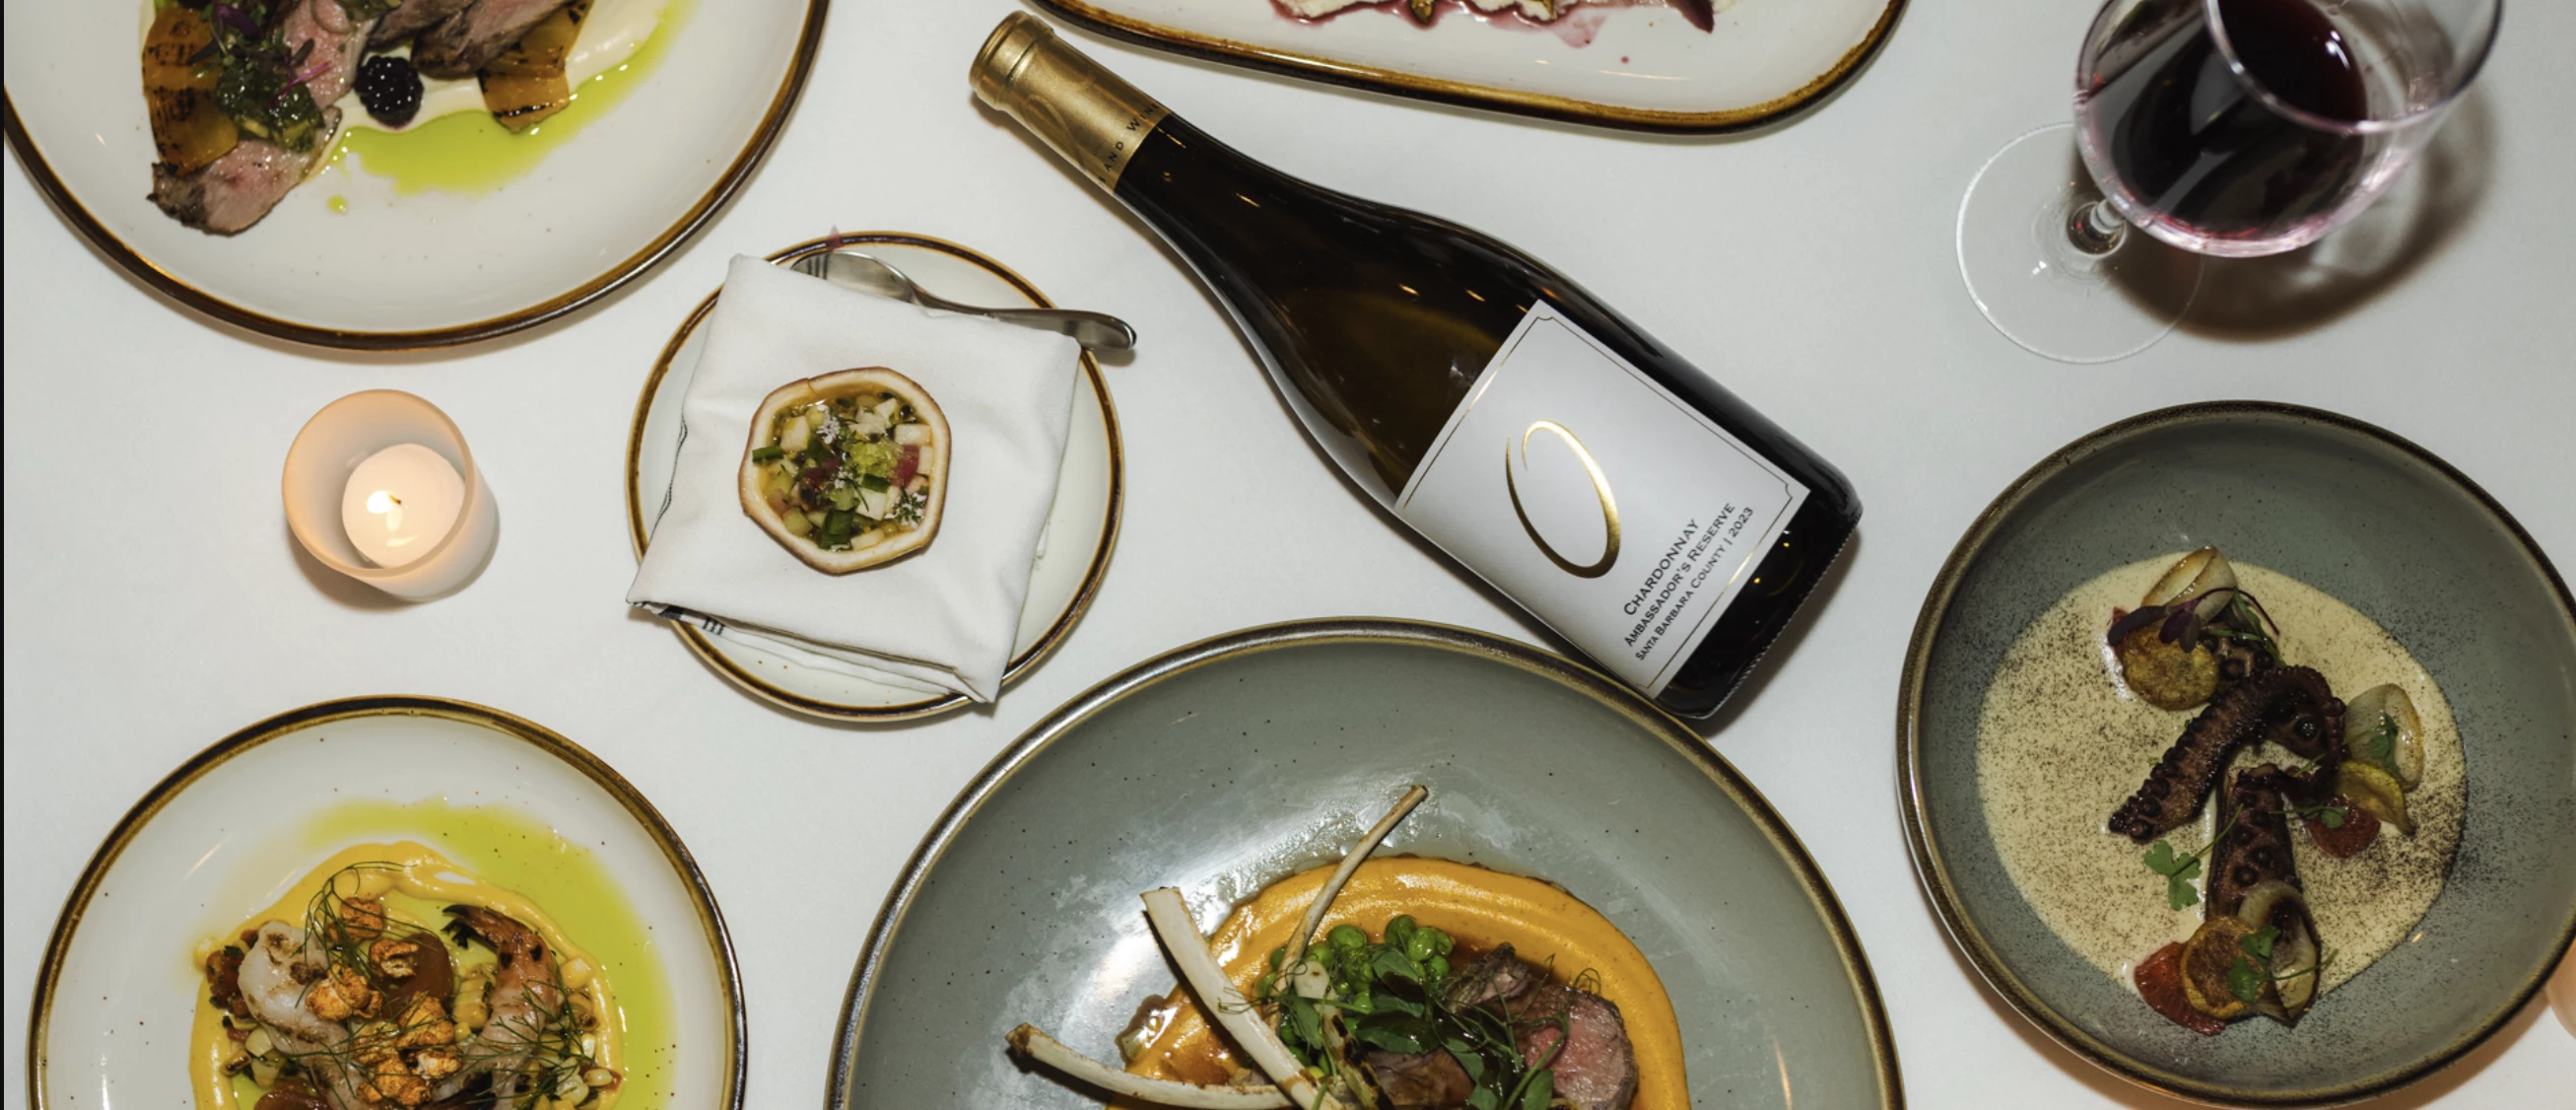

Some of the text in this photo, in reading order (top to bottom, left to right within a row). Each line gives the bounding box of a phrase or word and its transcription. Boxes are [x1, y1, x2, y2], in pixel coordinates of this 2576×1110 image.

[1104, 141, 1124, 172] AND
[1623, 519, 1699, 616] CHARDONNAY
[1624, 503, 1735, 647] AMBASSADOR'S RESERVE
[1636, 635, 1660, 660] SANTA
[1655, 590, 1694, 637] BARBARA
[1691, 545, 1726, 589] COUNTY
[1729, 507, 1753, 538] 2023
